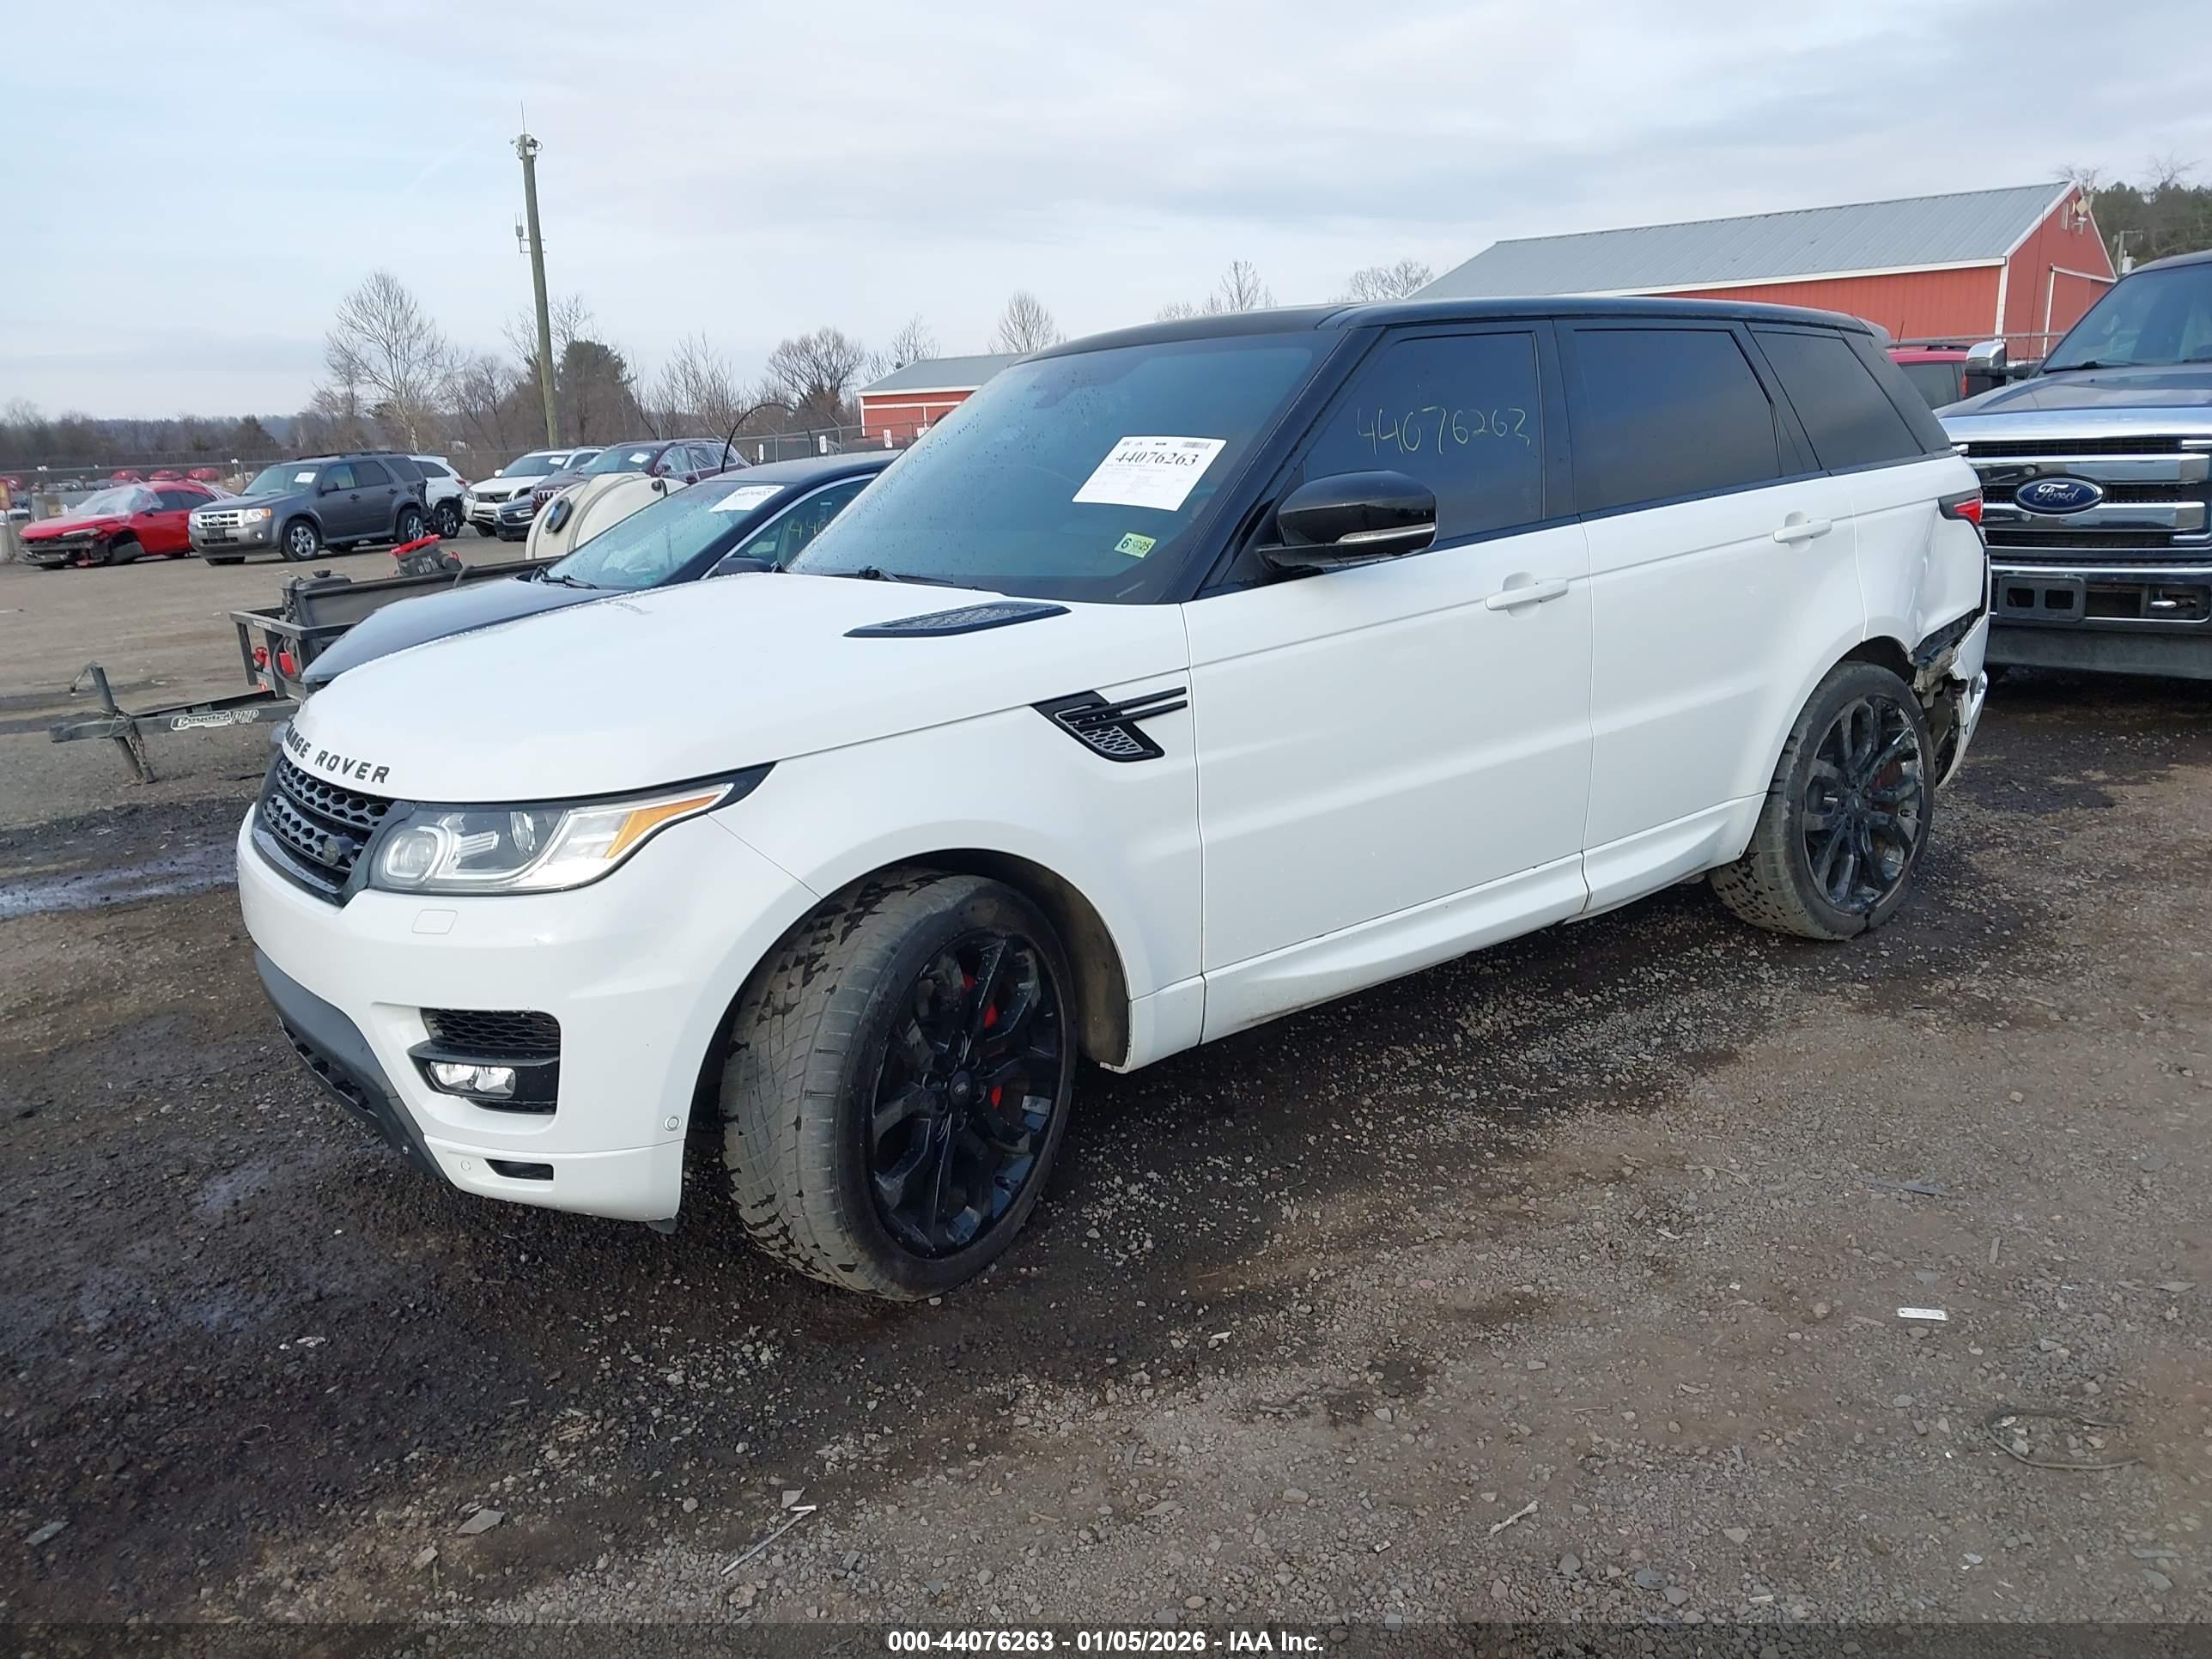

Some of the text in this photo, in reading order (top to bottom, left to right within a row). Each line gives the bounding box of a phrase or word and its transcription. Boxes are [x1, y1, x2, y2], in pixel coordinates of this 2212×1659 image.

[1357, 406, 1530, 455] 44076263
[1115, 451, 1199, 466] 44076263
[2034, 483, 2080, 502] Ford
[314, 750, 390, 784] ROVER
